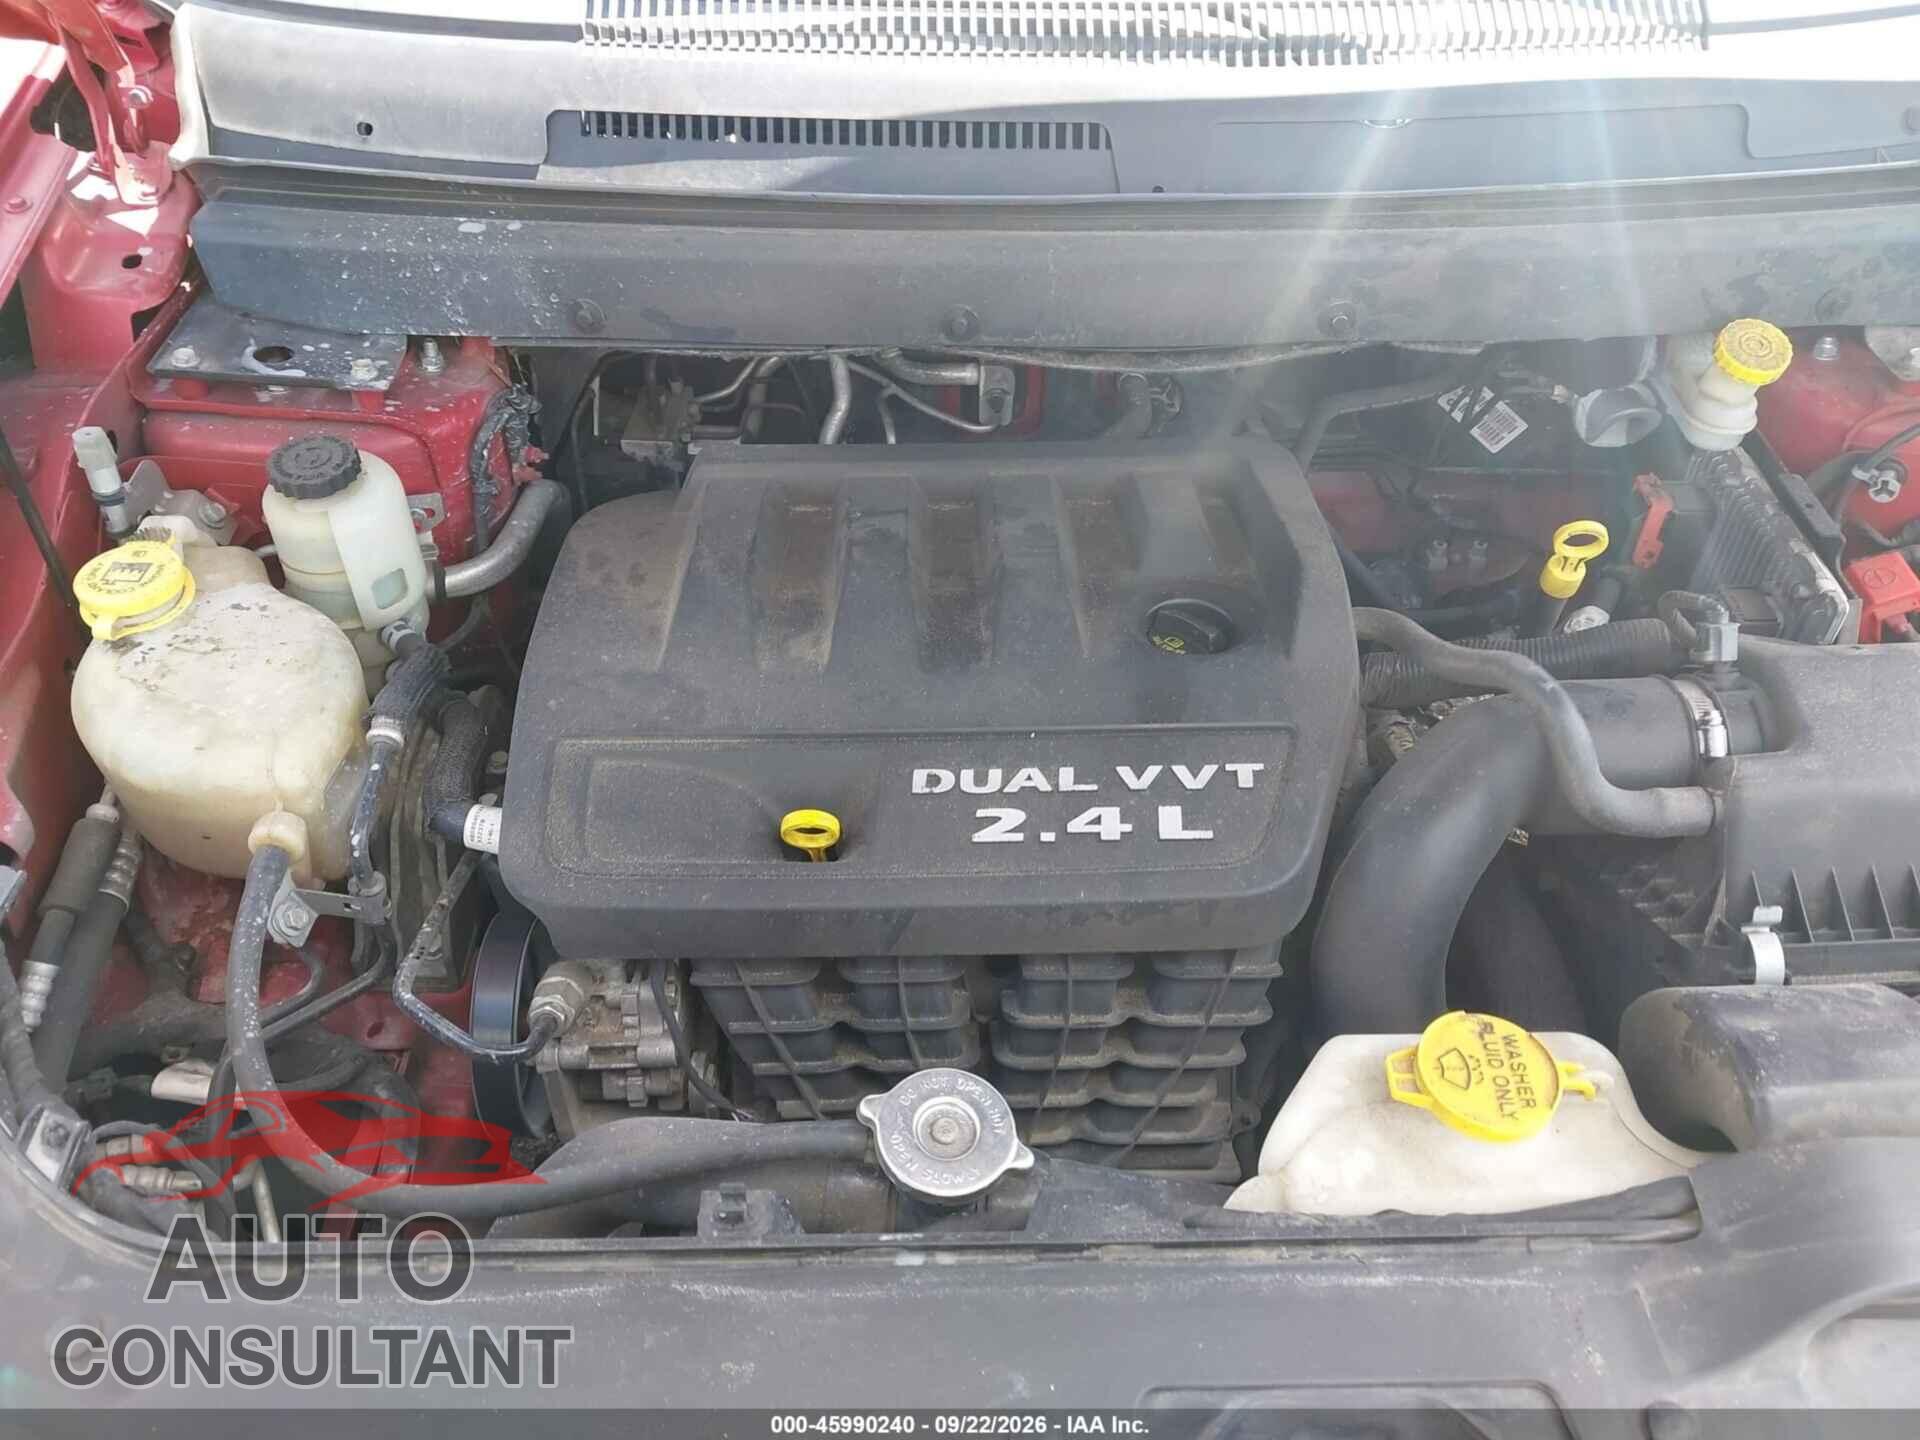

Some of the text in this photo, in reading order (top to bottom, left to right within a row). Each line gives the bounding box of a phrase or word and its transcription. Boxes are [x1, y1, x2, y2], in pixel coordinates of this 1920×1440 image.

[911, 763, 1265, 795] DUAL VVT
[1501, 1034, 1537, 1109] WASHER
[1491, 1074, 1519, 1121] ONLY
